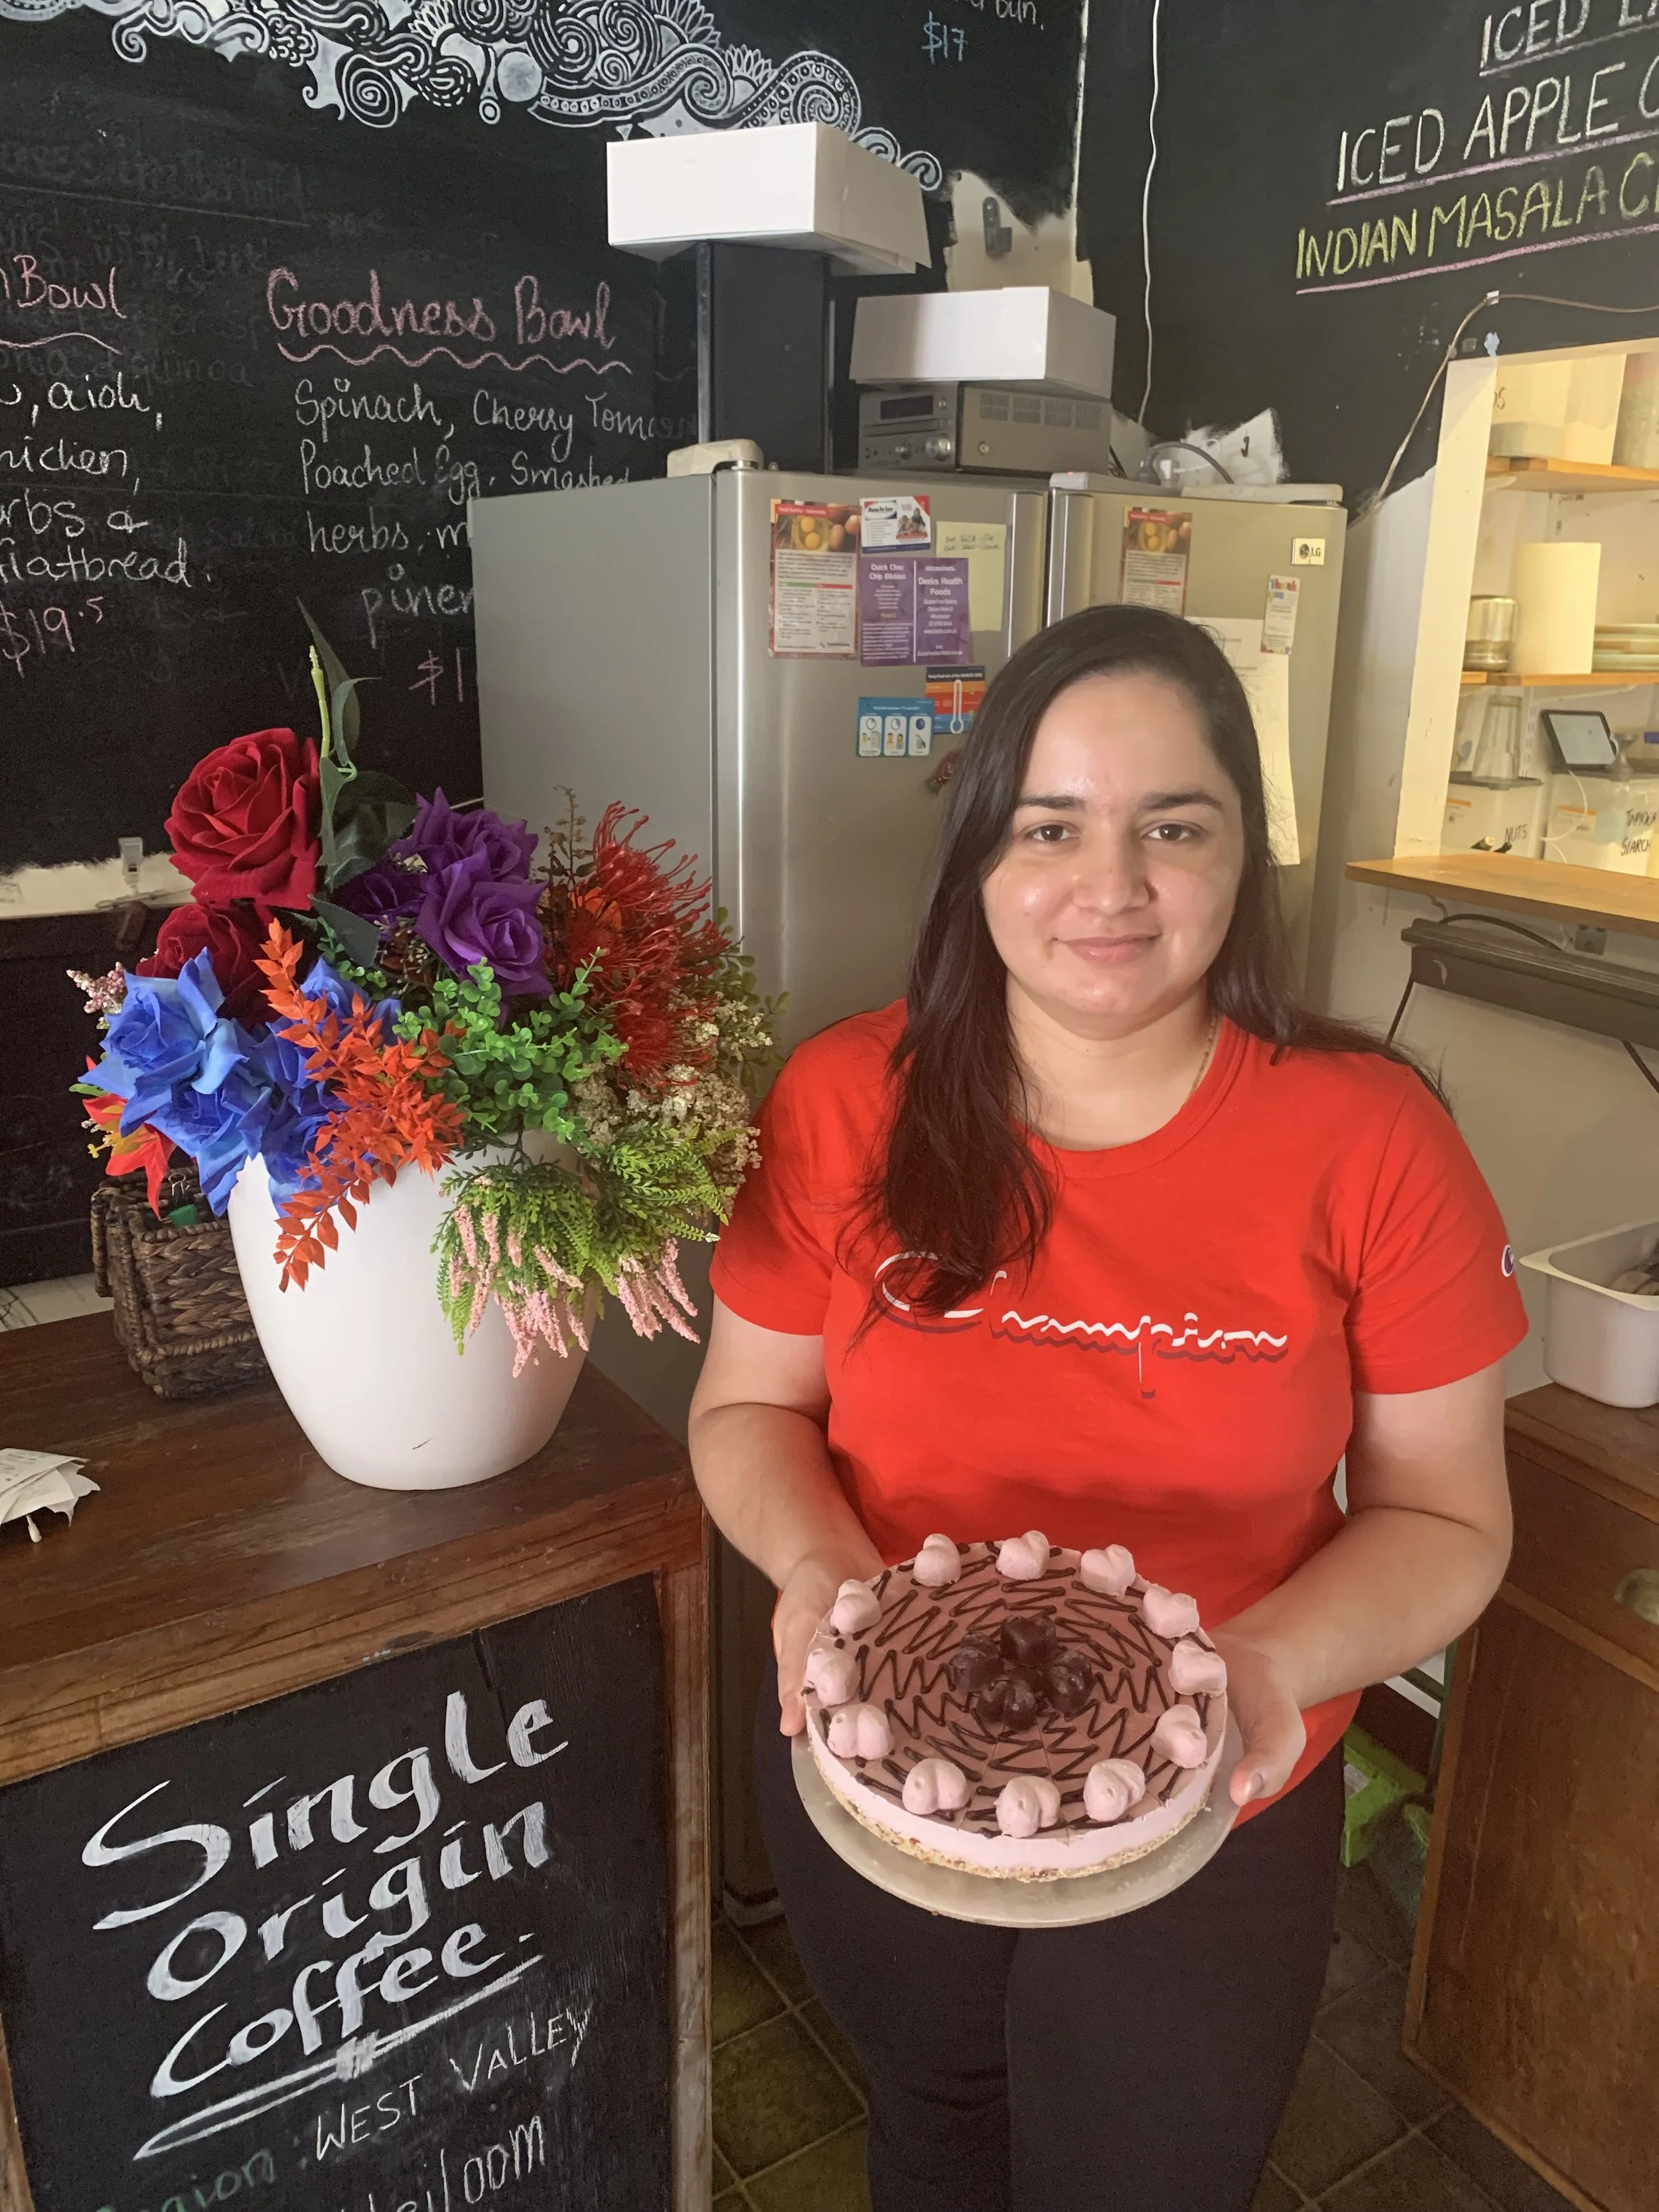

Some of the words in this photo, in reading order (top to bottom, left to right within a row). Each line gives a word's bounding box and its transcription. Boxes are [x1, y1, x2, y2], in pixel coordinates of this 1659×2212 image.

[921, 10, 968, 65] $17
[1480, 0, 1590, 68] ICED
[1337, 108, 1445, 192] ICED
[1463, 62, 1626, 160] APPLE
[1296, 208, 1417, 279] INDIAN
[1428, 165, 1609, 258] MASALA
[13, 254, 127, 319] Bowl
[265, 267, 496, 342] Goodness
[515, 275, 616, 350] Bowl
[295, 378, 455, 442] Spinach,
[301, 439, 425, 493] Poached
[435, 443, 496, 505] Egg,
[869, 573, 883, 581] Chip
[1309, 547, 1321, 557] LG
[1504, 824, 1528, 844] NUTS
[1621, 836, 1652, 856] STARCH
[82, 1690, 569, 1930] Single
[147, 1801, 549, 2001] Origin
[316, 2073, 423, 2162] WEST
[449, 2006, 591, 2096] VALLEY
